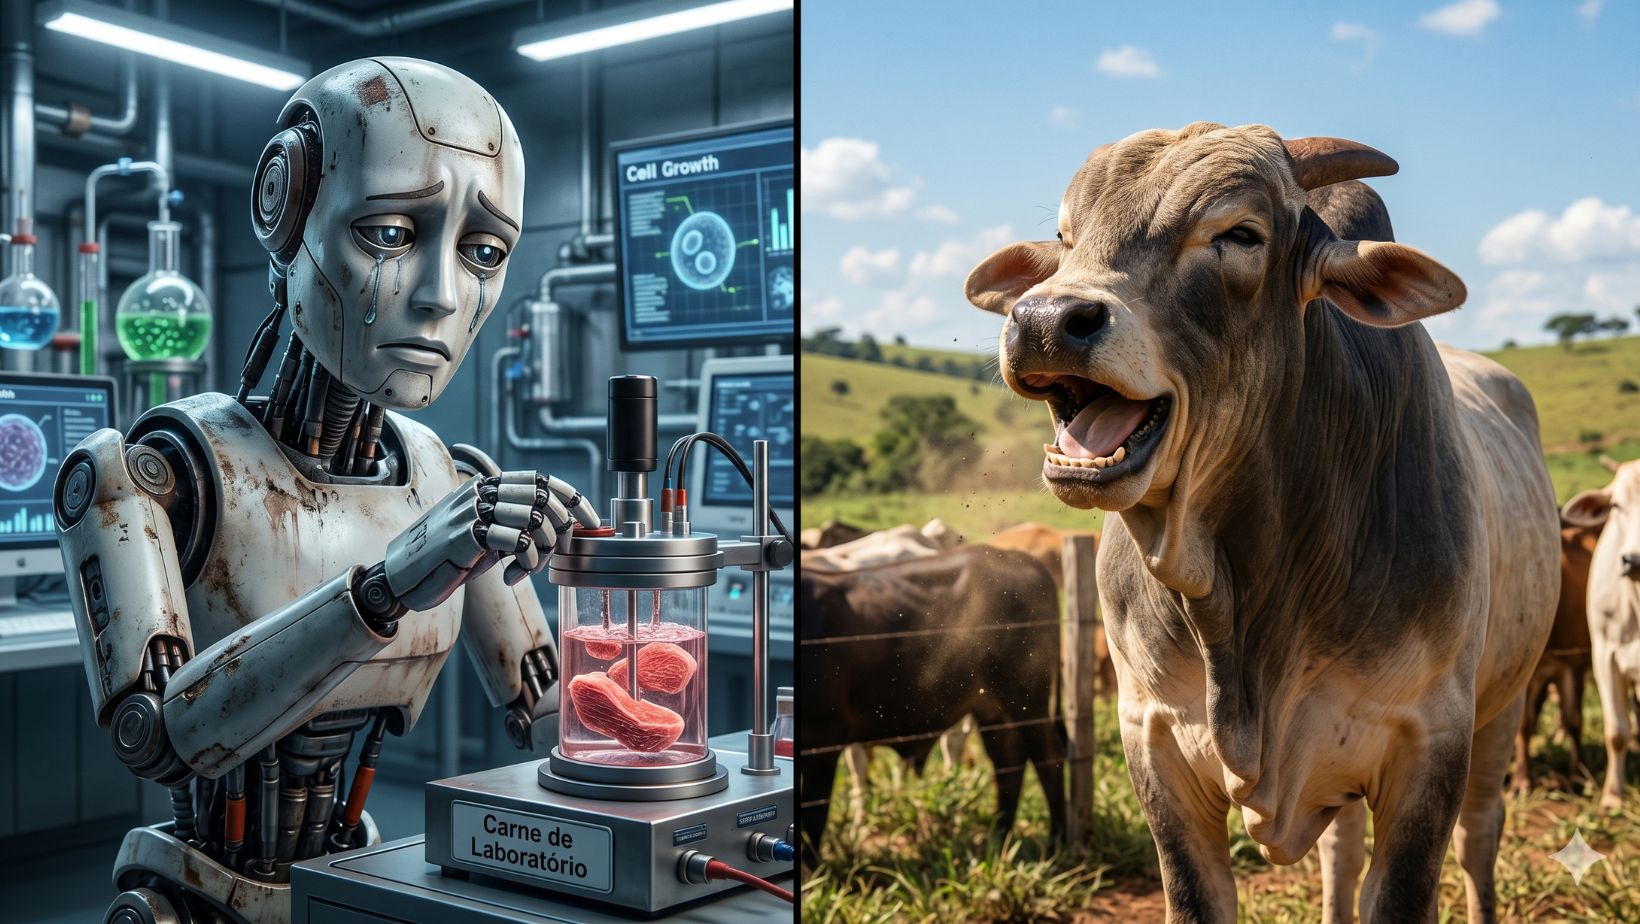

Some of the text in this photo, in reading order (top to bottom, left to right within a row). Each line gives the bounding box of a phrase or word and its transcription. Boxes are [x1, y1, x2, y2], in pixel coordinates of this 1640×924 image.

[626, 154, 719, 182] Cell Growth
[484, 814, 573, 849] Carne de
[471, 837, 588, 878] Laboratório
